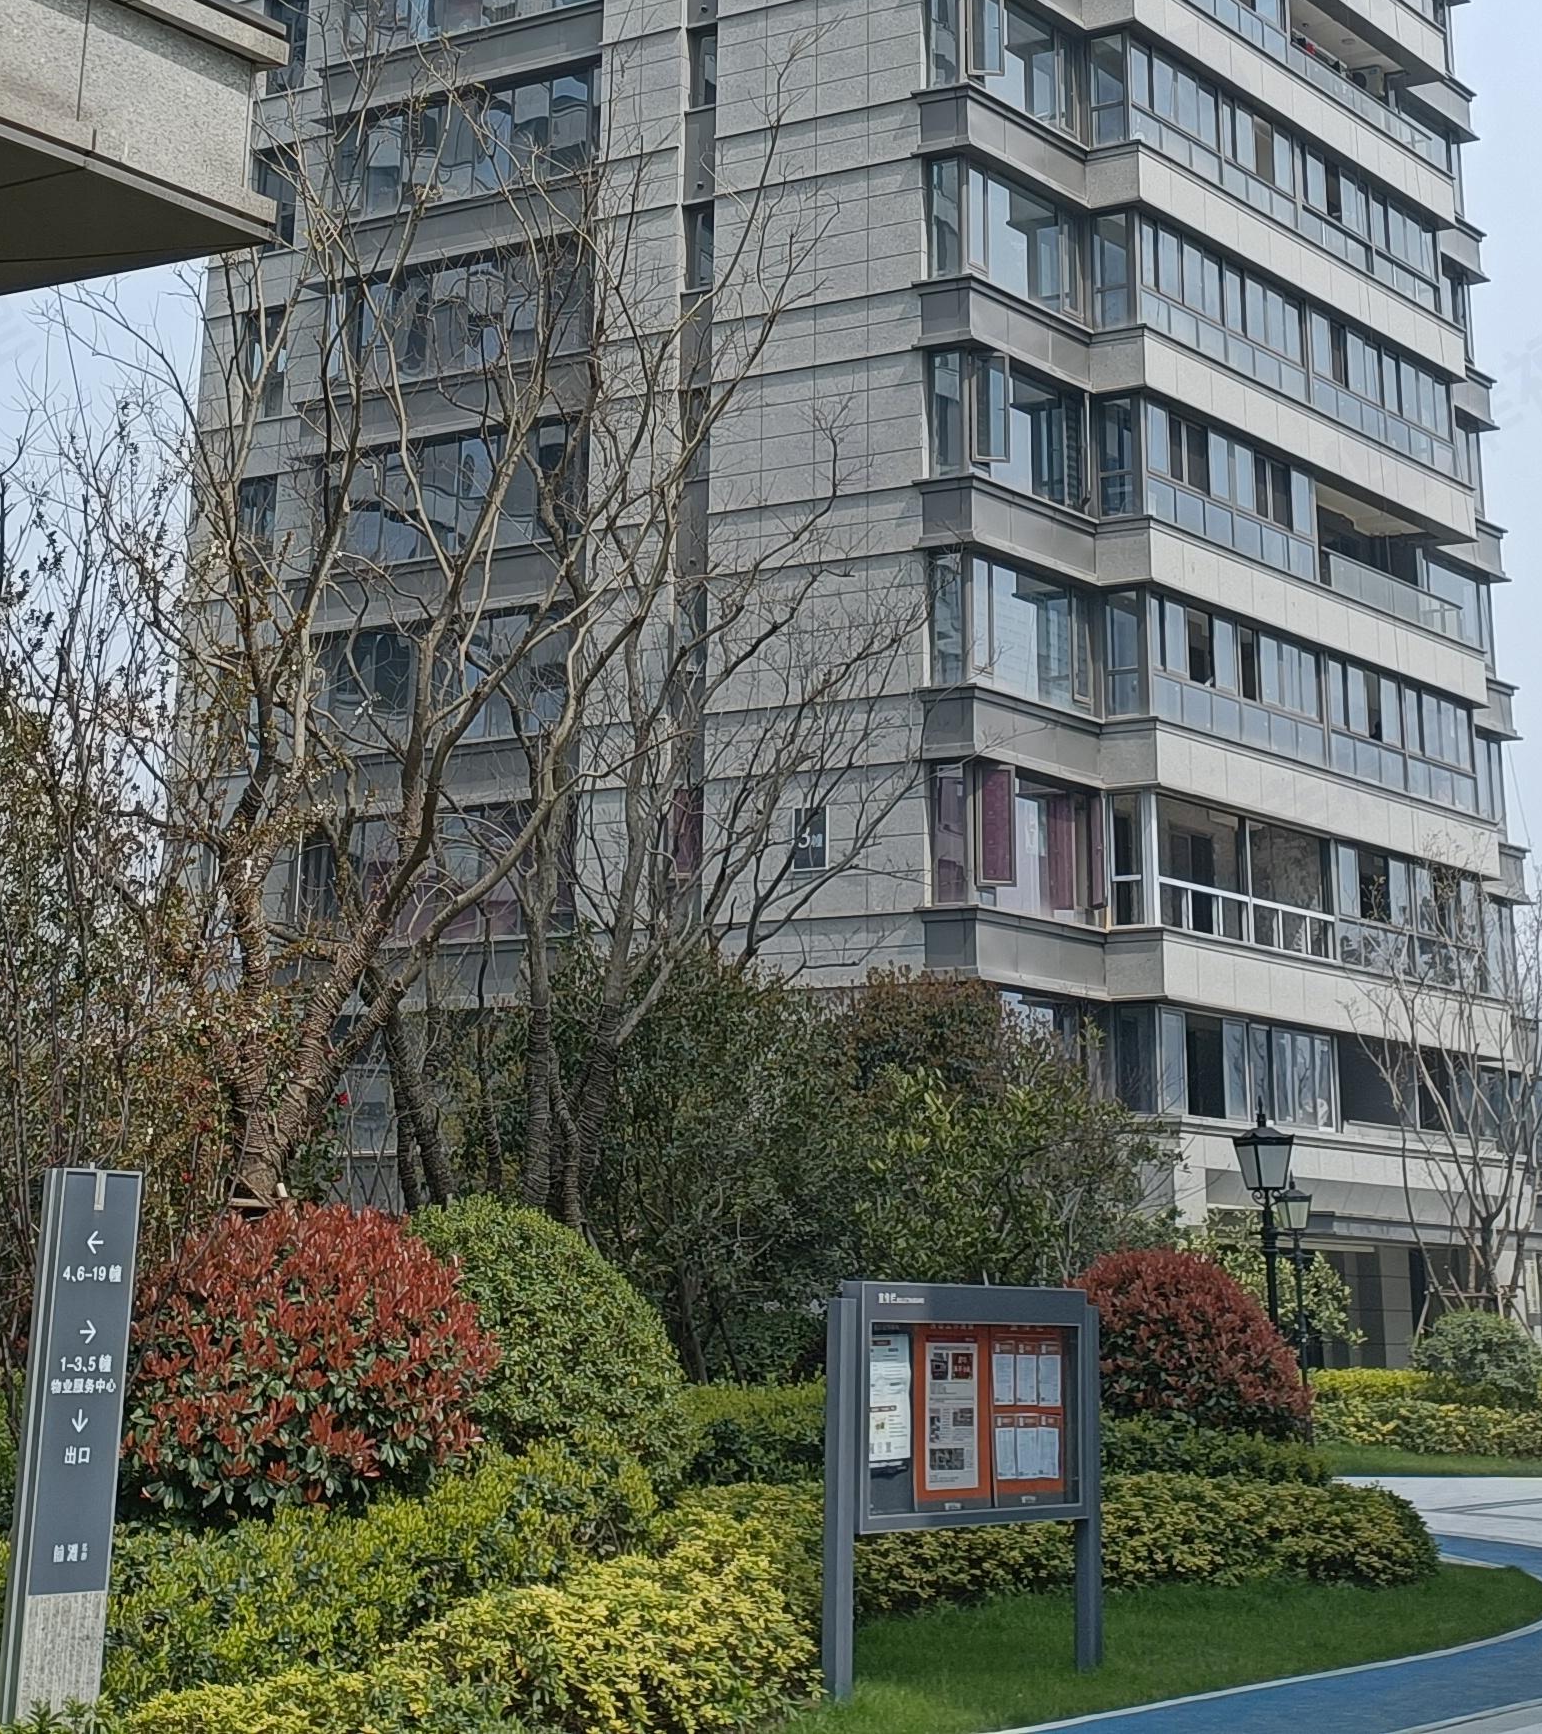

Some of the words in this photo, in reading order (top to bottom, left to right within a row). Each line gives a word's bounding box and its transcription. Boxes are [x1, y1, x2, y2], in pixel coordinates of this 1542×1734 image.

[50, 1378, 117, 1394] 物业服务中心
[64, 1445, 91, 1464] 出口
